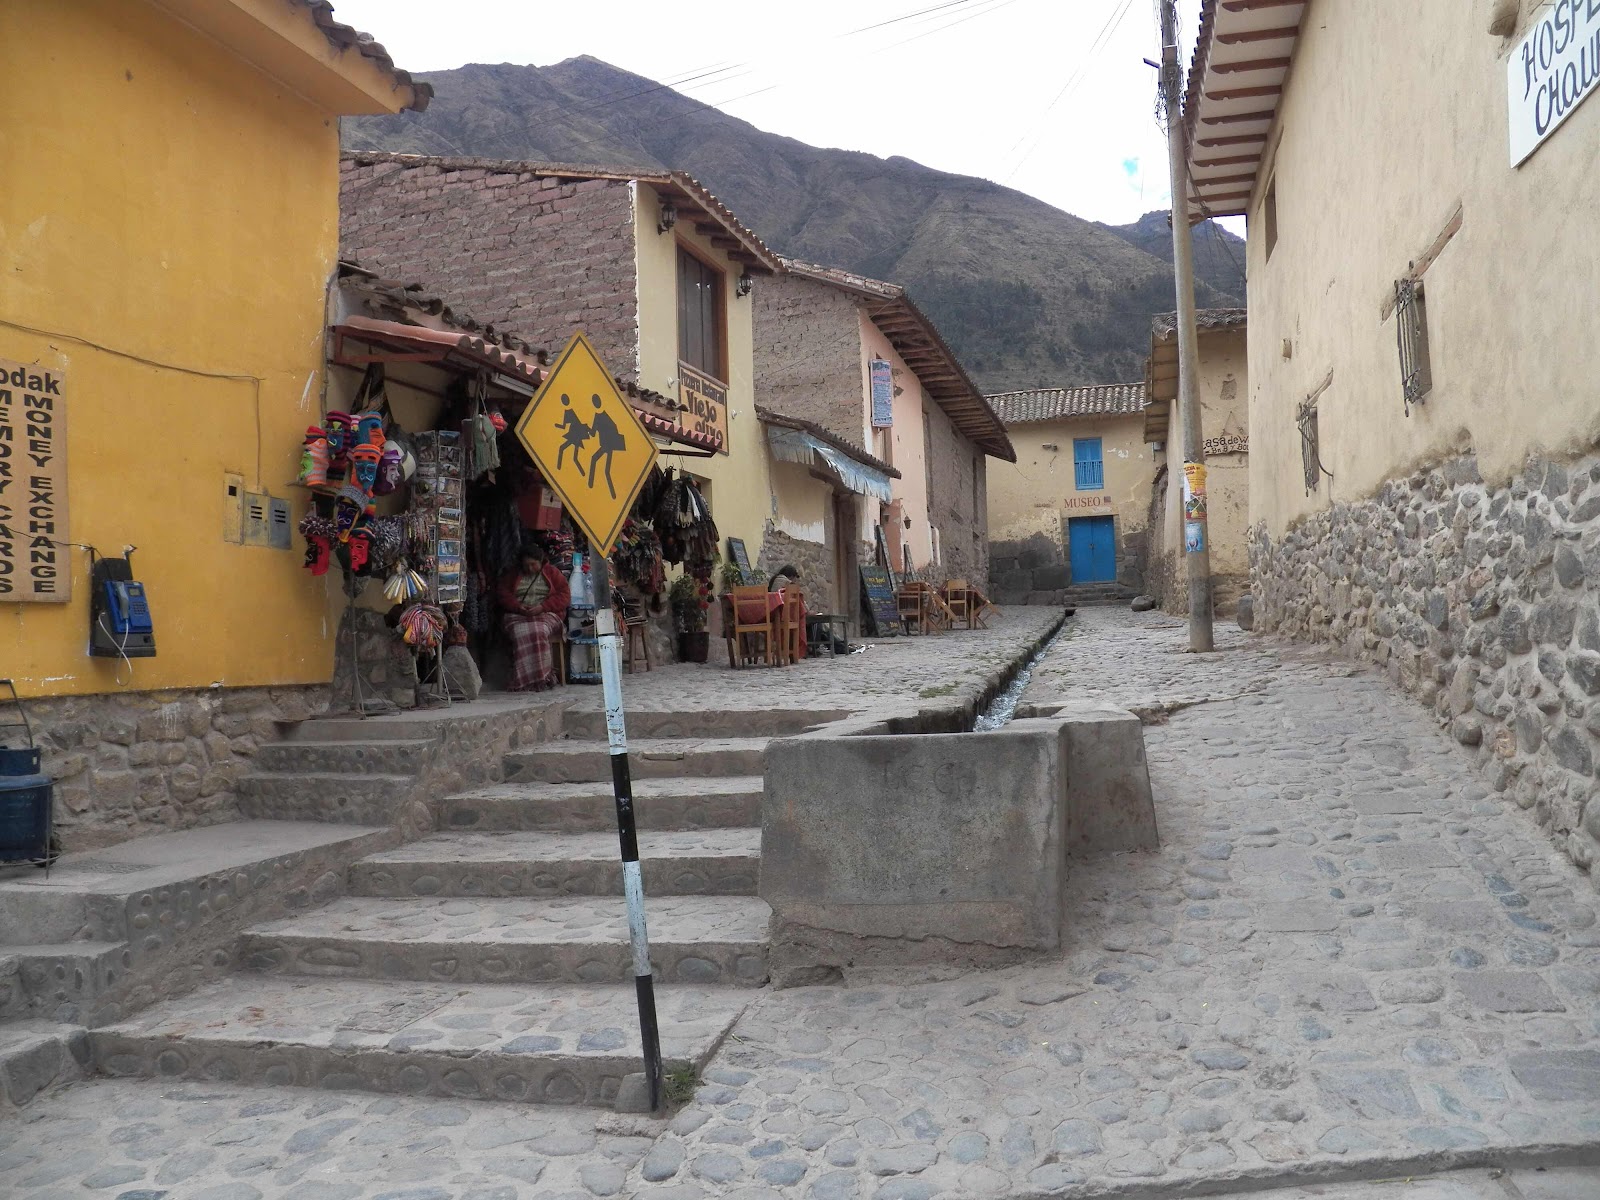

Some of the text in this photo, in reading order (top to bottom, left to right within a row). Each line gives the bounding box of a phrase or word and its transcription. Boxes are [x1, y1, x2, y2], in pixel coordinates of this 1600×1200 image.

[686, 390, 717, 422] Viejo
[24, 394, 56, 593] MONEY EXCHANGE
[1064, 496, 1101, 508] MUSEO
